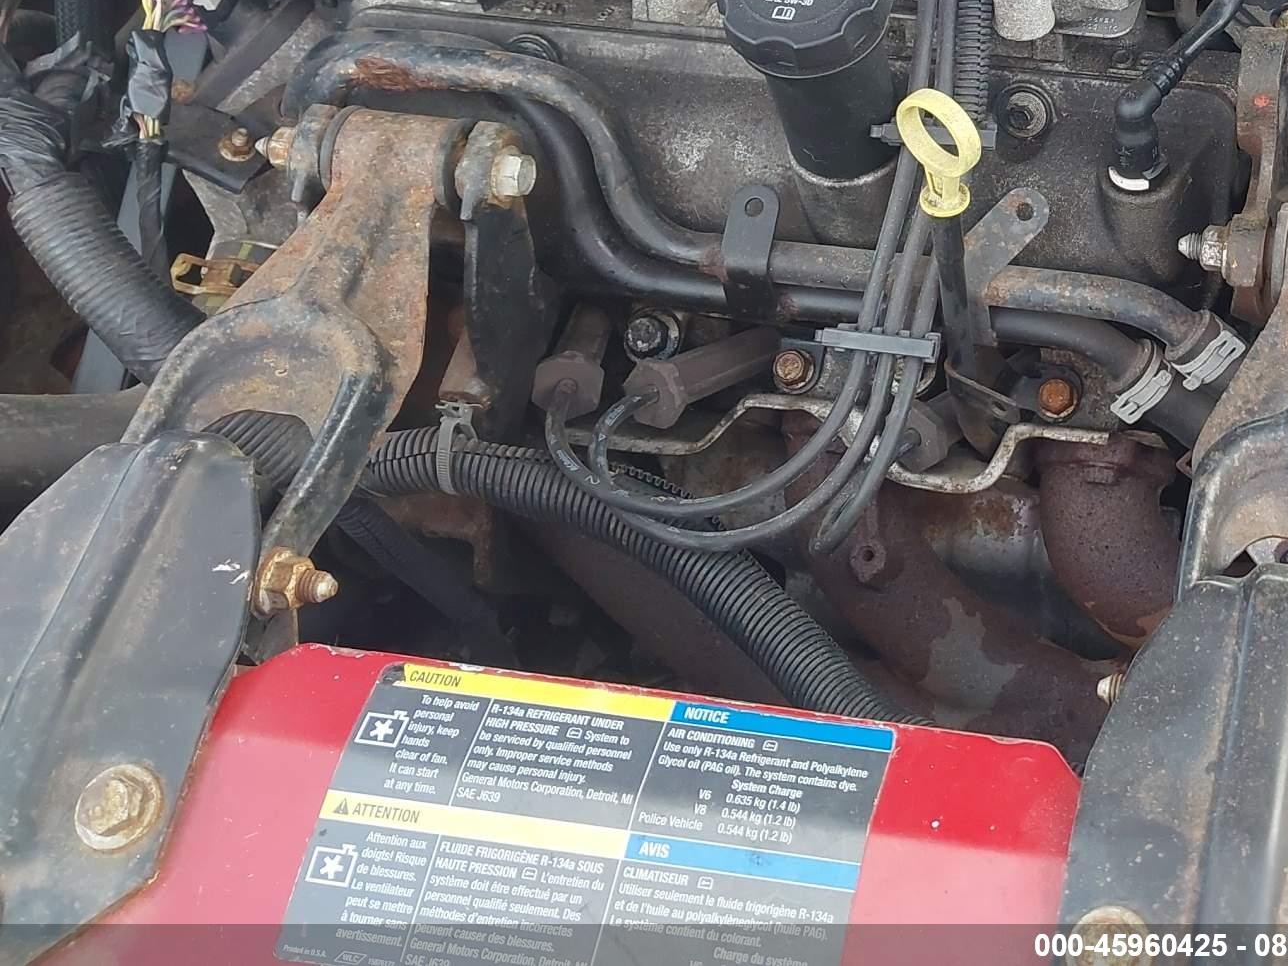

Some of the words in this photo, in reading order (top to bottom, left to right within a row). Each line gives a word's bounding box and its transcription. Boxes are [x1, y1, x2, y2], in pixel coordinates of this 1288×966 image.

[410, 670, 461, 687] CAUTION
[421, 694, 432, 705] To
[432, 696, 453, 709] help
[454, 701, 480, 711] avoid
[413, 710, 454, 722] personal
[491, 703, 525, 717] R-134a
[526, 708, 590, 725] REFRIGERANT
[591, 717, 624, 730] UNDER
[685, 707, 730, 723] NOTICE
[408, 721, 435, 735] injury,
[436, 724, 459, 738] keep
[485, 717, 510, 728] HIGH
[509, 720, 559, 735] PRESSURE
[584, 730, 618, 743] System
[620, 735, 630, 745] to
[667, 728, 686, 739] AIR
[687, 730, 755, 748] CONDITIONING
[401, 735, 430, 747] hands
[479, 730, 492, 741] be
[492, 734, 532, 746] serviced
[532, 737, 545, 750] by
[545, 741, 586, 753] qualified
[585, 747, 632, 759] personnel
[395, 748, 420, 760] clear
[419, 752, 432, 762] of
[430, 752, 447, 764] fan.
[473, 745, 493, 757] only.
[496, 747, 538, 761] Improper
[538, 754, 574, 766] service
[573, 759, 613, 771] methods
[663, 741, 681, 752] Use
[682, 745, 702, 757] only
[703, 746, 737, 760] R-134a
[739, 752, 790, 767] Refrigerant
[790, 760, 810, 770] and
[810, 761, 868, 778] Polyalkylene
[389, 762, 397, 773] It
[398, 765, 415, 775] can
[416, 767, 439, 778] start
[467, 759, 488, 771] may
[488, 762, 516, 773] cause
[516, 766, 558, 778] personal
[558, 770, 585, 784] injury.
[658, 755, 687, 767] Glycol
[687, 759, 700, 769] oil
[701, 761, 724, 772] (PAG
[724, 765, 741, 776] oil).
[745, 766, 761, 777] The
[762, 771, 796, 782] system
[798, 776, 837, 788] contains
[838, 780, 856, 792] dye.
[384, 778, 395, 789] at
[395, 779, 413, 793] any
[414, 781, 435, 794] time.
[456, 786, 477, 799] SAE
[476, 790, 500, 802] J639
[462, 771, 497, 786] General
[497, 776, 529, 790] Motors
[531, 781, 584, 799] Corporation,
[586, 788, 618, 804] Detroit,
[621, 793, 634, 804] MI
[731, 779, 767, 793] System
[768, 784, 802, 799] Charge
[699, 789, 712, 800] V6
[726, 793, 753, 805] 0.635
[753, 796, 766, 810] kg
[767, 799, 786, 811] (1.4
[787, 801, 800, 814] lb)
[352, 803, 419, 823] ATTENTION
[694, 802, 707, 815] V8
[721, 807, 748, 820] 0.544
[749, 811, 763, 825] kg
[764, 813, 782, 825] (1.2
[783, 816, 796, 830] lb)
[638, 811, 668, 825] Police
[669, 815, 702, 830] Vehicle
[717, 823, 744, 836] 0.544
[745, 826, 758, 840] kg
[759, 828, 779, 841] (1.2
[779, 831, 792, 845] lb)
[366, 831, 408, 847] Attention
[409, 839, 427, 849] aux
[639, 841, 669, 858] AVIS
[361, 846, 394, 861] doigts!
[395, 851, 429, 866] Risque
[440, 841, 474, 856] FLUIDE
[475, 846, 539, 865] FRIGORIGÈNE
[540, 853, 575, 870] R-134a
[577, 858, 604, 874] SOUS
[356, 863, 369, 874] de
[435, 857, 468, 872] HAUTE
[468, 862, 517, 878] PRESSION
[591, 879, 604, 891] du
[623, 866, 688, 885] CLIMATISEUR
[351, 878, 363, 890] Le
[365, 882, 414, 897] ventilateur
[430, 872, 469, 888] système
[470, 879, 489, 891] doit
[490, 880, 510, 894] être
[511, 883, 550, 900] effectué
[550, 889, 569, 903] par
[569, 894, 582, 904] un
[345, 896, 368, 907] peut
[368, 899, 381, 909] se
[382, 901, 413, 914] mettre
[424, 888, 472, 908] personnel
[472, 896, 508, 911] qualifié
[562, 908, 581, 923] Des
[619, 881, 653, 897] Utiliser
[653, 886, 704, 905] seulement
[703, 894, 715, 909] le
[717, 896, 743, 910] fluide
[745, 901, 797, 918] frigorigène
[798, 908, 833, 924] R-134a
[349, 912, 382, 924] tourner
[420, 905, 466, 921] méthodes
[614, 897, 625, 911] et
[625, 898, 639, 912] de
[671, 905, 685, 919] au
[774, 920, 803, 935] (huile
[414, 920, 453, 937] peuvent
[451, 929, 487, 941] causer
[488, 931, 506, 945] des
[666, 921, 705, 938] contient
[706, 929, 722, 941] du
